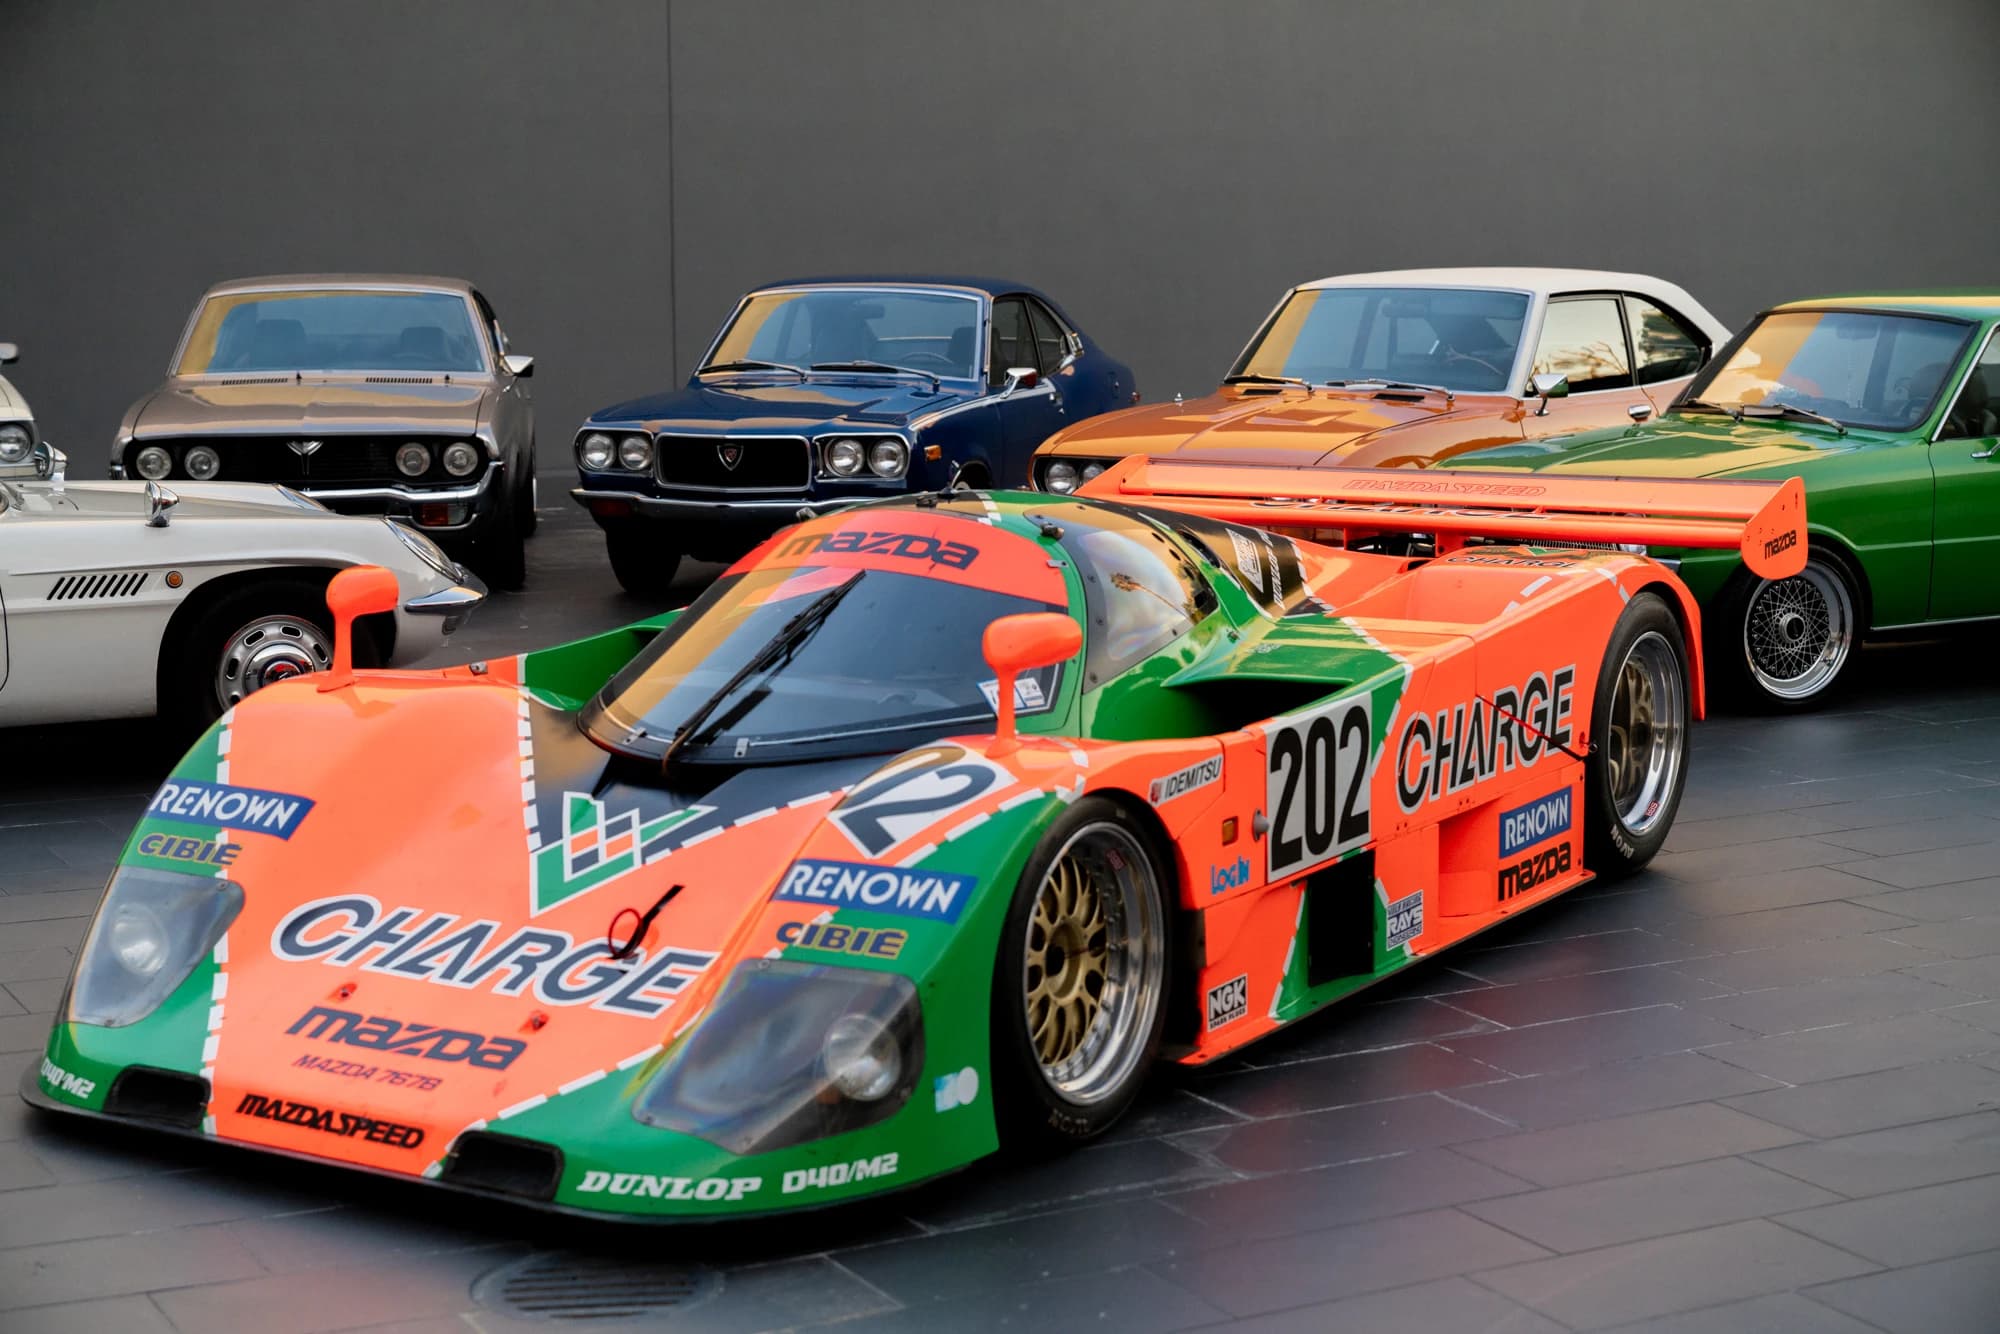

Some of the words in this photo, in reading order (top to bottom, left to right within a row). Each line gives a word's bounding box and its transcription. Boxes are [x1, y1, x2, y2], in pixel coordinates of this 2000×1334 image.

[776, 531, 980, 571] mazda
[1764, 529, 1797, 561] mazda
[1396, 664, 1576, 815] CHARGE
[1165, 756, 1222, 799] IDEMITSU
[1270, 705, 1370, 872] 202
[150, 783, 300, 831] RENOWN
[1504, 793, 1569, 851] RENOWN
[779, 864, 961, 914] RENOWN
[1498, 841, 1571, 902] mazda
[270, 893, 722, 1020] CHARGE
[1210, 978, 1246, 1020] NGK
[285, 1006, 529, 1070] mazda
[292, 1054, 375, 1080] MAZDA
[576, 1170, 763, 1201] DUNLOP
[781, 1152, 899, 1194] D40/M2
